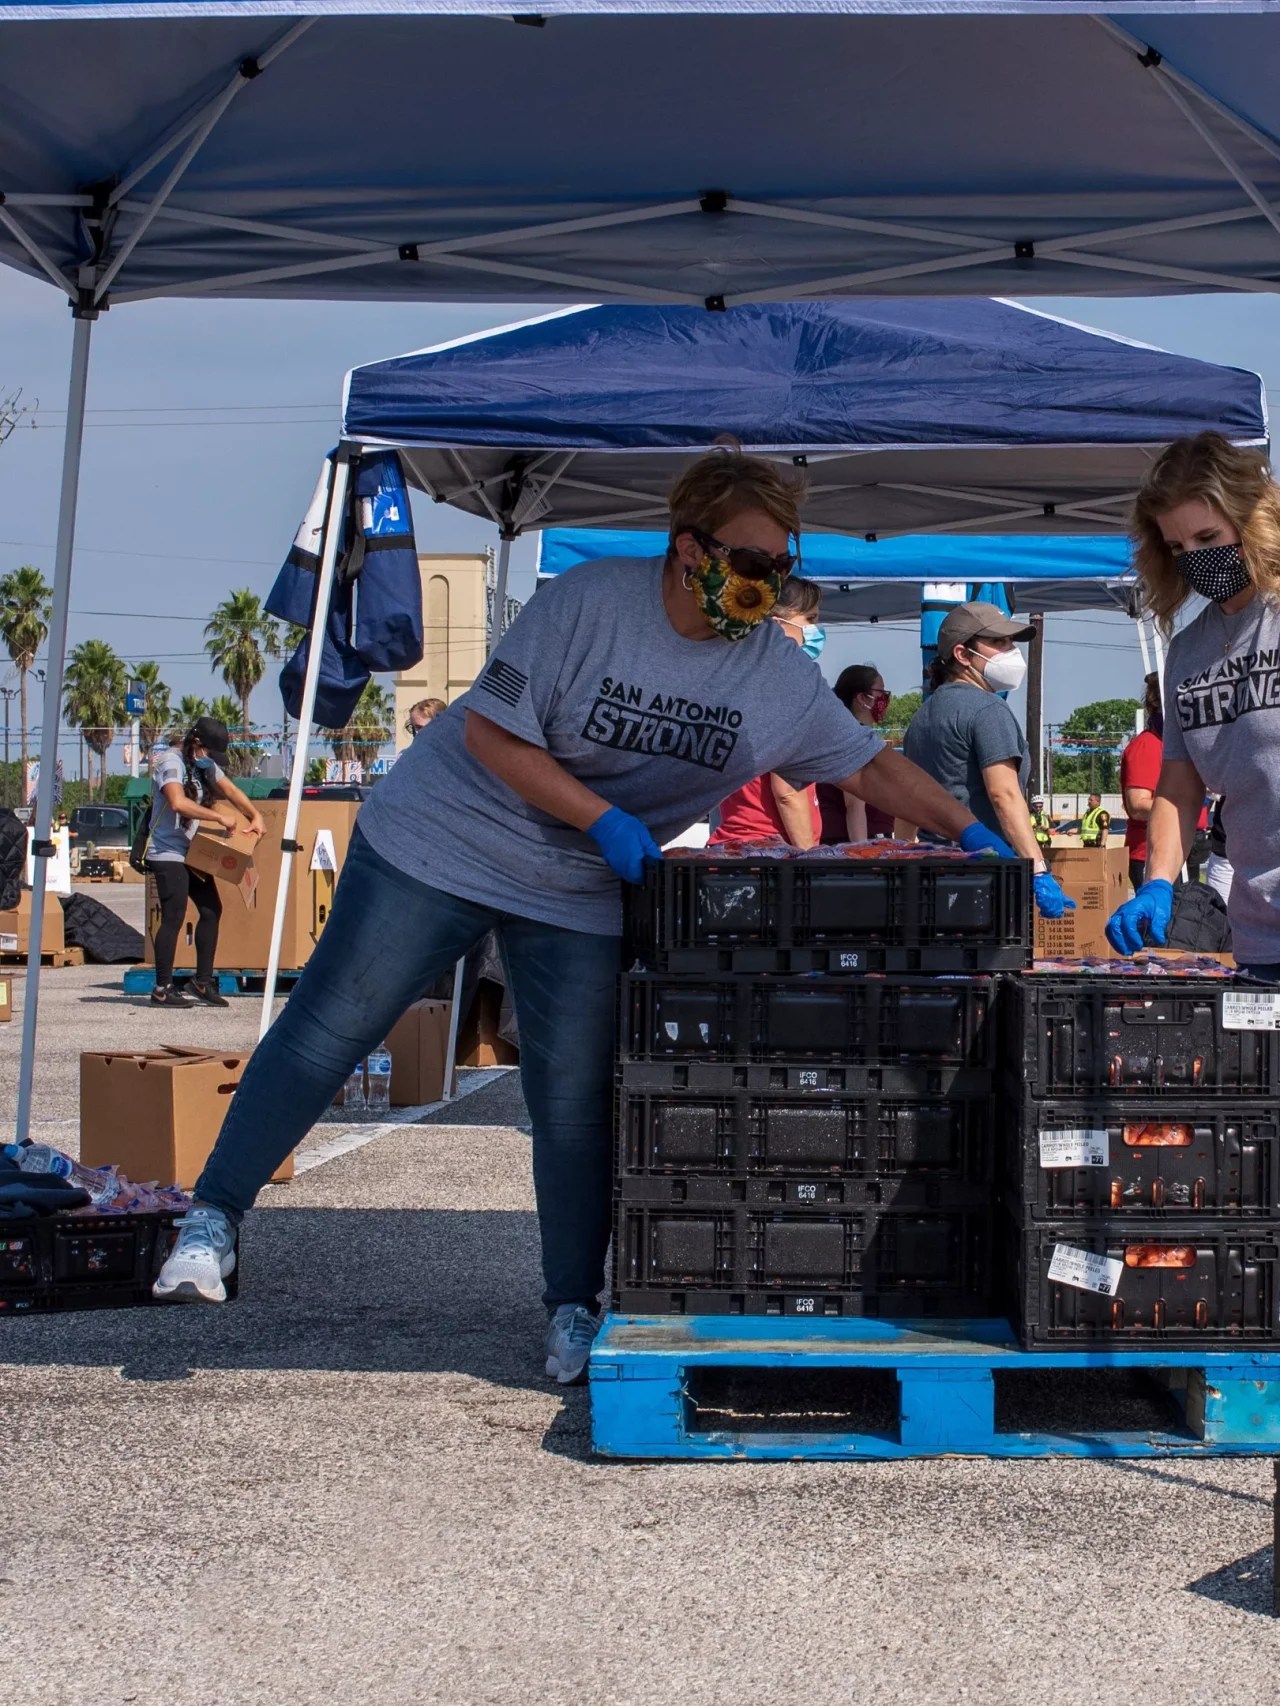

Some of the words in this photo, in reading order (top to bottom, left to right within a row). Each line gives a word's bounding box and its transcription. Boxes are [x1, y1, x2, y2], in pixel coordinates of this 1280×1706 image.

[600, 676, 643, 707] SAN
[648, 693, 743, 729] ANTONIO
[587, 702, 734, 768] STRONG
